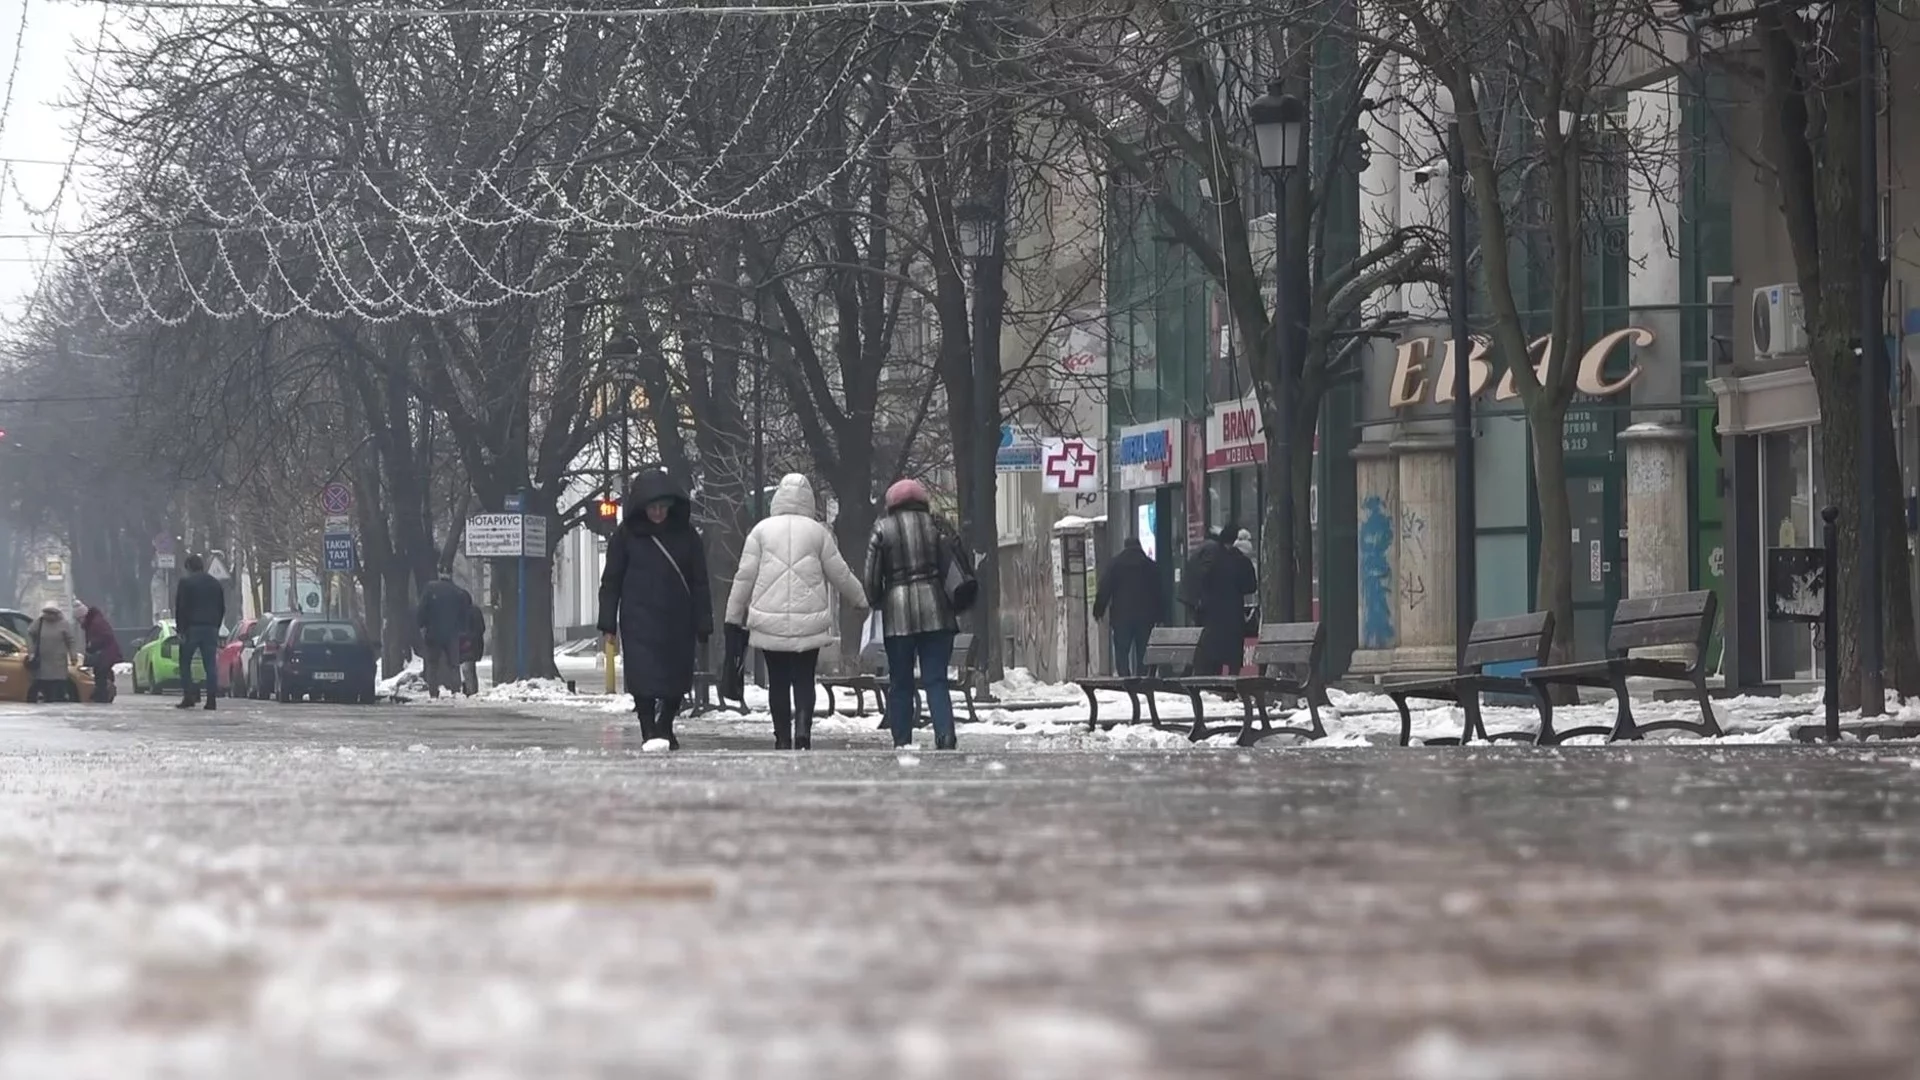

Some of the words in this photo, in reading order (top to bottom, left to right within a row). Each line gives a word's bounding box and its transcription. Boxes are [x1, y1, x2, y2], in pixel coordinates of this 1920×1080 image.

[1223, 407, 1256, 442] BRAVO
[1226, 447, 1254, 463] MOBILE
[468, 515, 520, 526] НОТАРИУС
[325, 540, 351, 549] ТАКСИ
[328, 550, 348, 559] TAXI
